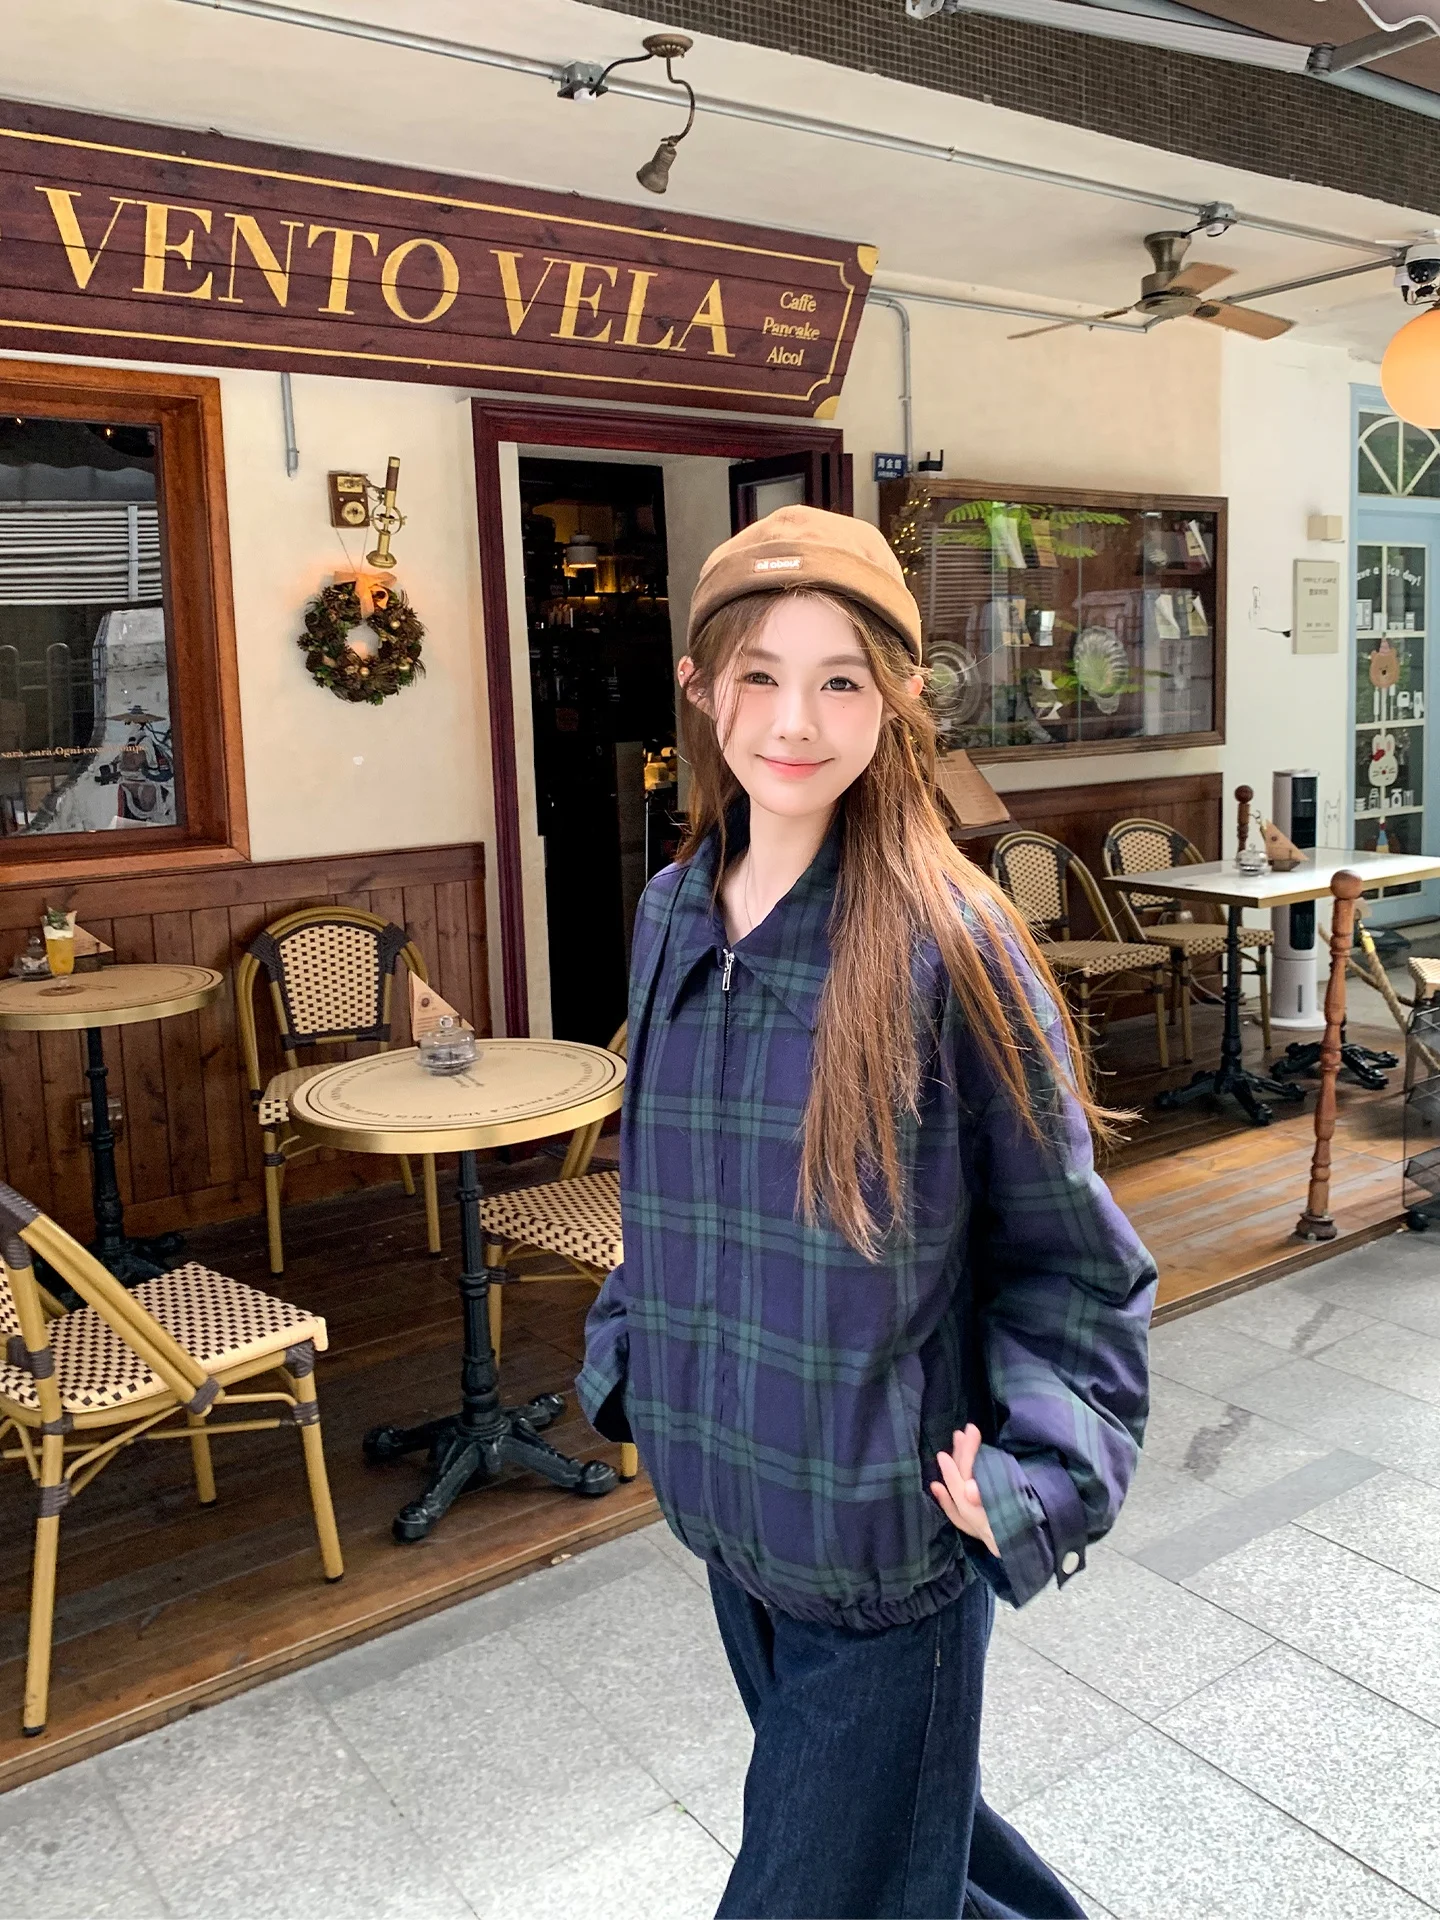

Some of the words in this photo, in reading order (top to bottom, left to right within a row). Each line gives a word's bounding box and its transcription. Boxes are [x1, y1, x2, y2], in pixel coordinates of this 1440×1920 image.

[35, 185, 459, 324] VENTO
[490, 249, 736, 358] VELA
[762, 316, 820, 340] Pancake
[766, 346, 805, 366] Alcol
[1356, 568, 1371, 581] ave
